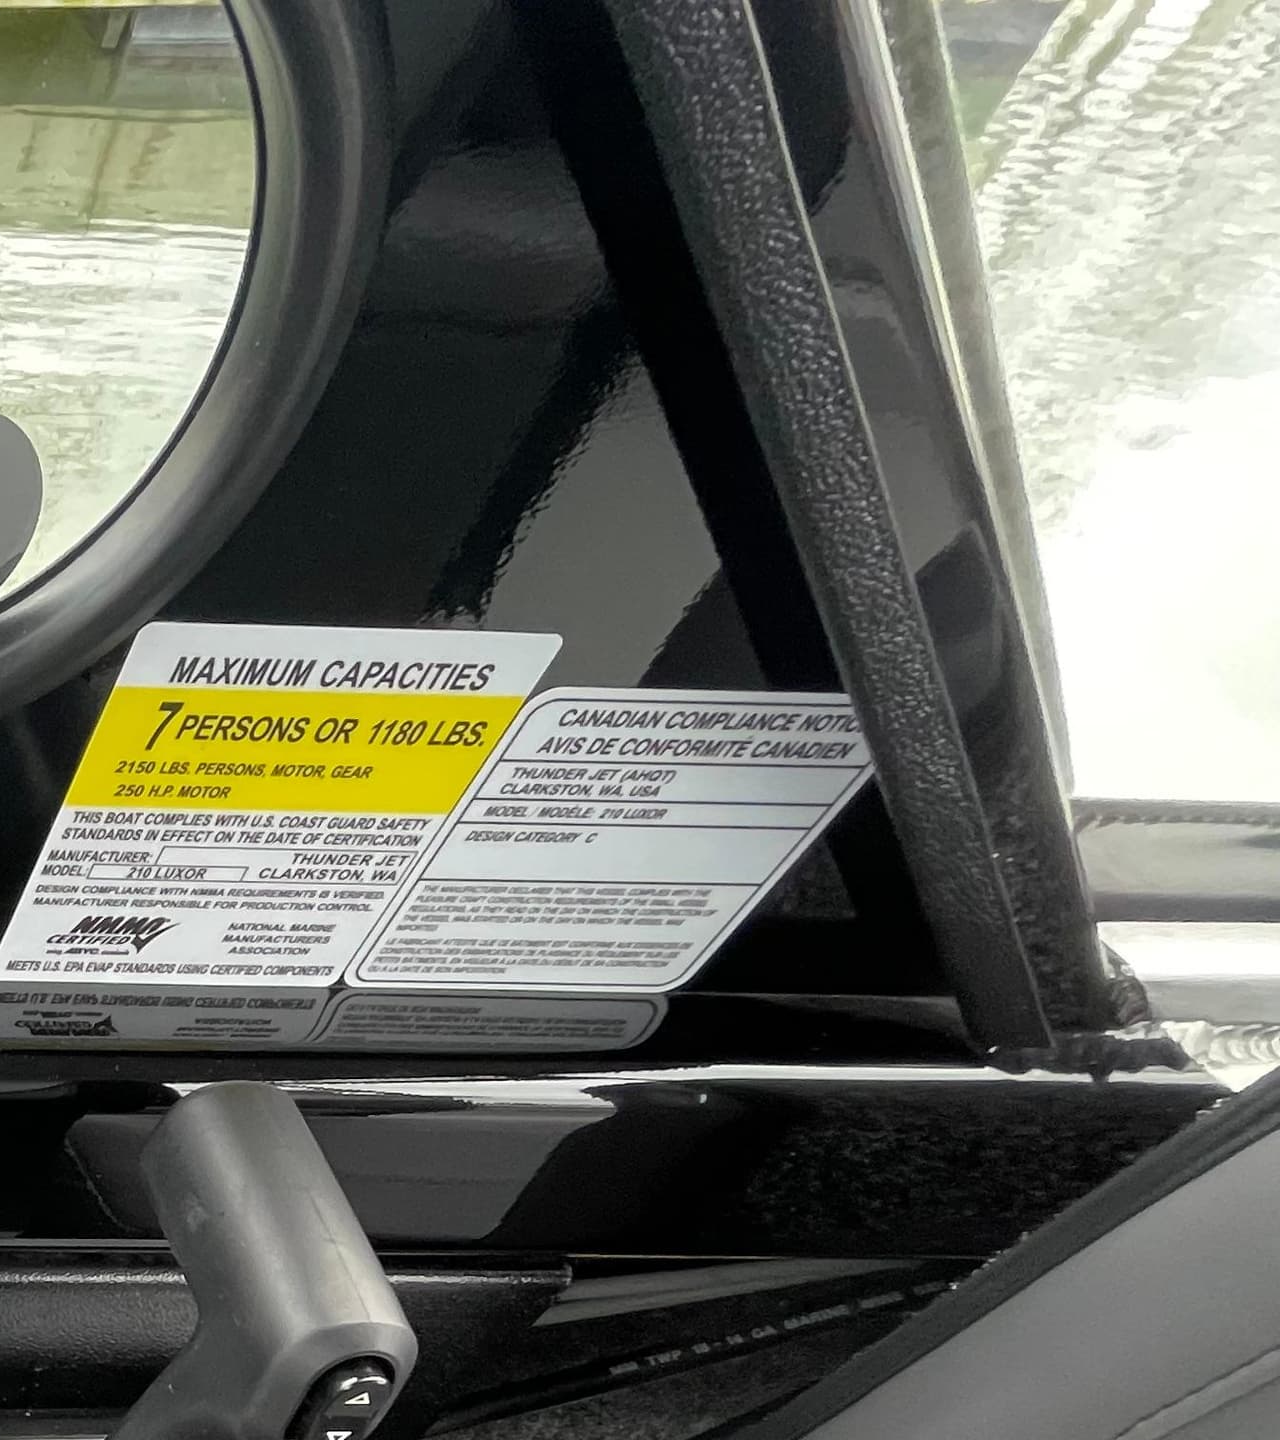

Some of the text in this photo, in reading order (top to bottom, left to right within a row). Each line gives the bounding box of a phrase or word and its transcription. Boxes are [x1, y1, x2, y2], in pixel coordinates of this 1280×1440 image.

[169, 656, 496, 691] MAXIMUM CAPACITIES
[145, 701, 489, 750] 7 PERSONS OR 1180 LBS.
[558, 708, 863, 733] CANADIAN COMPLIANCE NOTIC
[536, 736, 858, 759] AVIS DE CONFORMITÉ CANADIEN
[114, 760, 156, 774] 2150
[159, 761, 190, 775] LBS.
[195, 762, 267, 777] PERSONS,
[331, 766, 374, 779] GEAR
[511, 767, 587, 780] THUNDER
[588, 768, 622, 781] JET
[114, 784, 232, 799] 250 H.P. MOTOR
[629, 785, 661, 797] USA
[483, 806, 528, 818] MODEL
[72, 811, 432, 831] THIS BOAT COMPLIES WITH U.S. COAST GUARD SAFETY
[61, 827, 423, 846] STANDARDS IN EFFECT ON THE DATE OF CERTIFICATION
[464, 830, 599, 843] DESIGN CATEGORY C
[46, 850, 410, 867] MANUFACTURER: THUNDER JET
[40, 864, 88, 877] MODEL:
[126, 867, 153, 879] 210
[154, 867, 207, 879] LUXOR
[371, 869, 397, 881] WA
[35, 885, 79, 894] DESIGN
[81, 886, 157, 895] COMPLIANCE
[159, 887, 188, 896] WITH
[32, 897, 128, 908] MANUFACTURER
[130, 898, 211, 909] RESPONSIBLE
[212, 900, 238, 909] FOR
[240, 901, 315, 911] PRODUCTION
[227, 922, 286, 931] NATIONAL
[46, 934, 131, 945] CERTIFIED
[221, 934, 331, 944] MANUFACTURERS
[227, 946, 311, 955] ASSOCIATION
[6, 960, 41, 971] MEETS
[64, 961, 85, 972] EPA
[86, 961, 114, 973] EVAP
[113, 962, 175, 974] STANDARDS
[176, 964, 210, 975] USING
[210, 964, 263, 975] CERTIFIED
[263, 965, 335, 976] COMPONENTS
